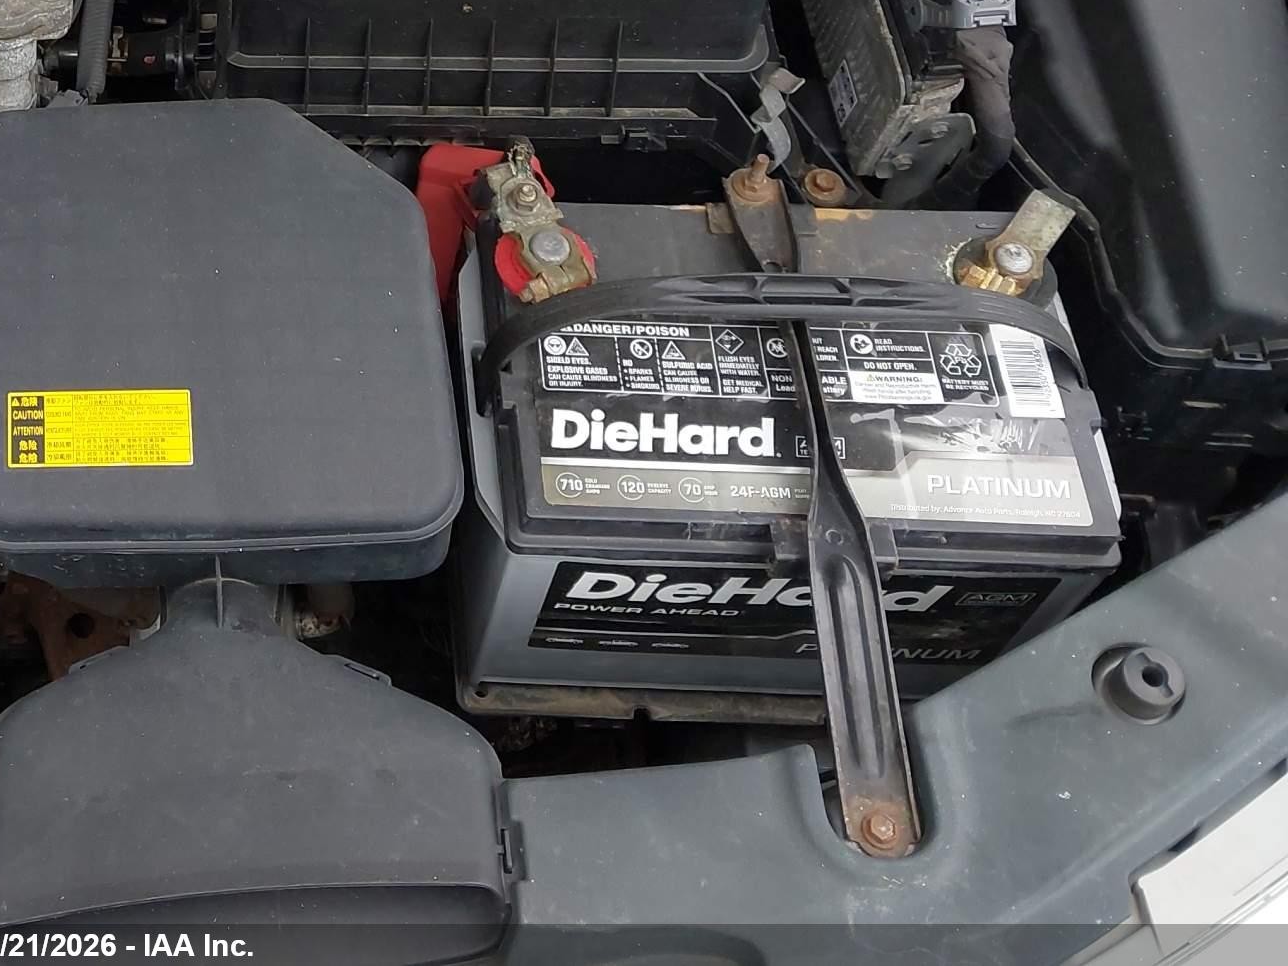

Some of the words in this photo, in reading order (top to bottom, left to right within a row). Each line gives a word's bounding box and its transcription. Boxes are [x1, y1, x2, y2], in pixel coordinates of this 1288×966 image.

[573, 323, 690, 337] DANGER/POISON
[547, 366, 585, 374] EXPLOSIVE
[877, 362, 892, 370] NOT
[893, 363, 917, 371] OPEN.
[13, 410, 43, 420] CAUTION
[13, 426, 43, 436] ATTENTION
[550, 408, 775, 457] DieHard
[560, 478, 583, 491] 710
[620, 481, 645, 493] 120
[683, 484, 701, 495] 70
[927, 474, 1071, 499] PLATINUM
[730, 485, 791, 498] 24F-AGM
[891, 503, 929, 512] Distributed
[944, 506, 974, 514] Advance
[566, 571, 954, 612] DieHad
[969, 593, 1028, 601] AGM
[553, 602, 643, 614] POWER
[650, 607, 739, 616] AHEAD
